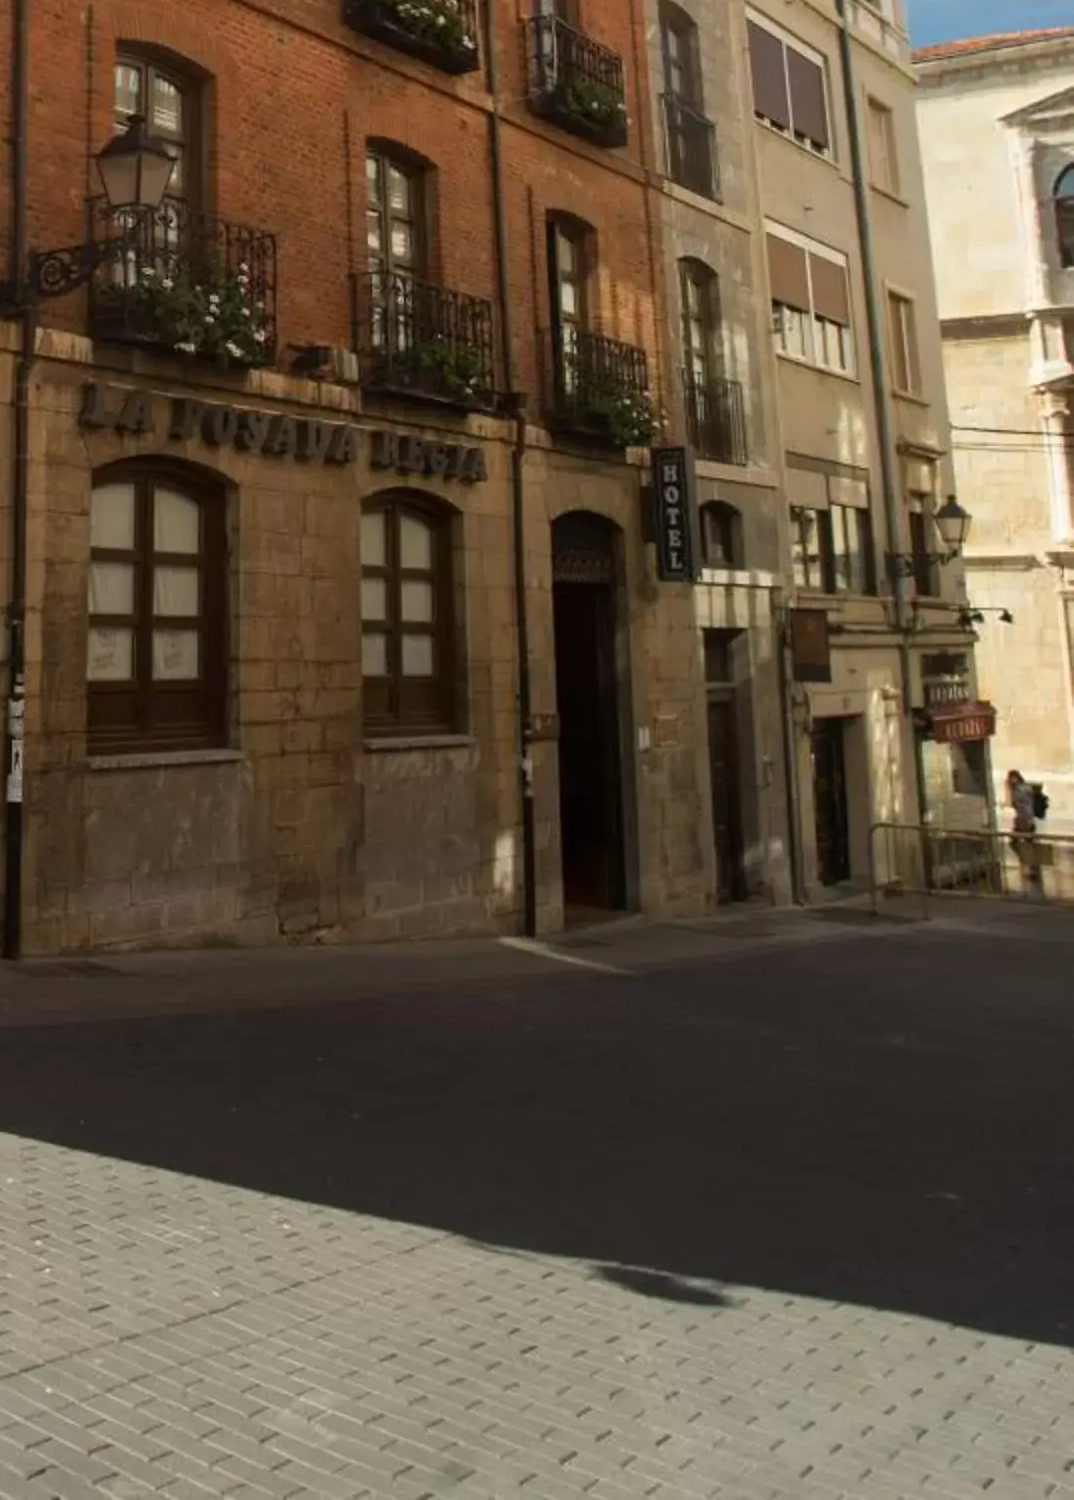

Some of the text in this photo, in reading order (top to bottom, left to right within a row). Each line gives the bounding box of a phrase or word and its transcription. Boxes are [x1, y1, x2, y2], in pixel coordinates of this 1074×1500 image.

[78, 383, 488, 486] LA POSADA REGIA
[662, 465, 683, 570] HOTEL
